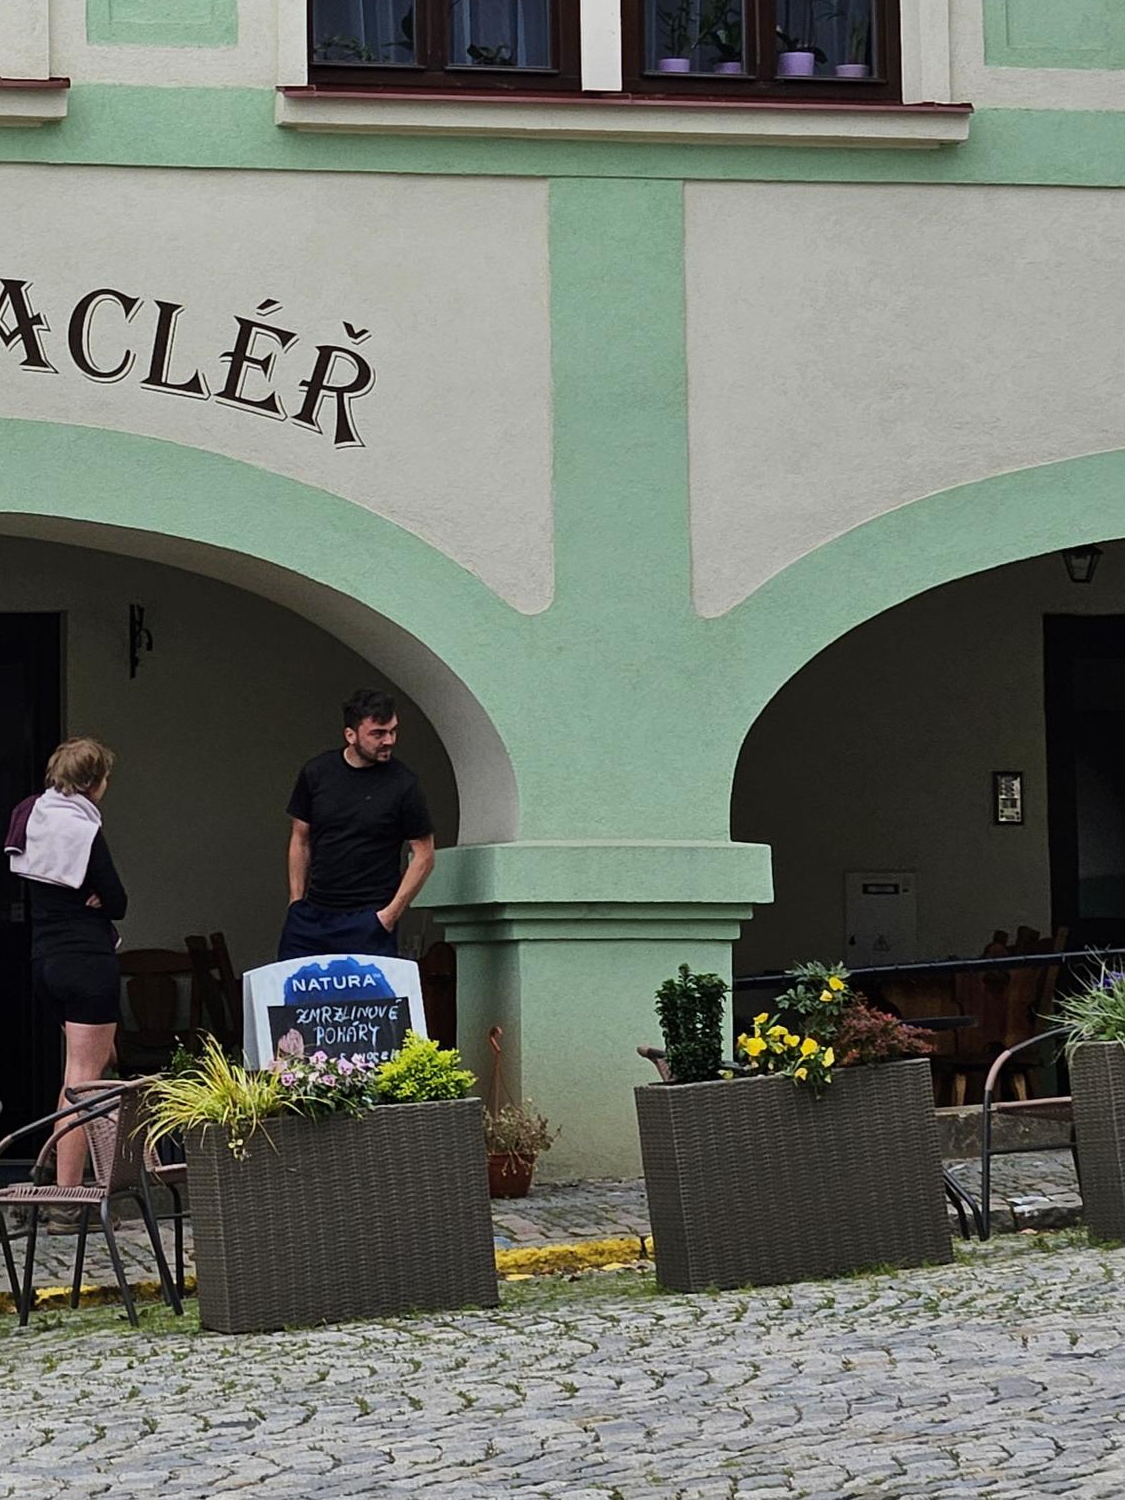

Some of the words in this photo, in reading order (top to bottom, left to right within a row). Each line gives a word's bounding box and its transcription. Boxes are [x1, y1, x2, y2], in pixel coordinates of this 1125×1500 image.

[292, 974, 376, 992] NATURA
[296, 998, 402, 1024] ZMRZLINOVÉ
[314, 1022, 380, 1047] POHÁRY
